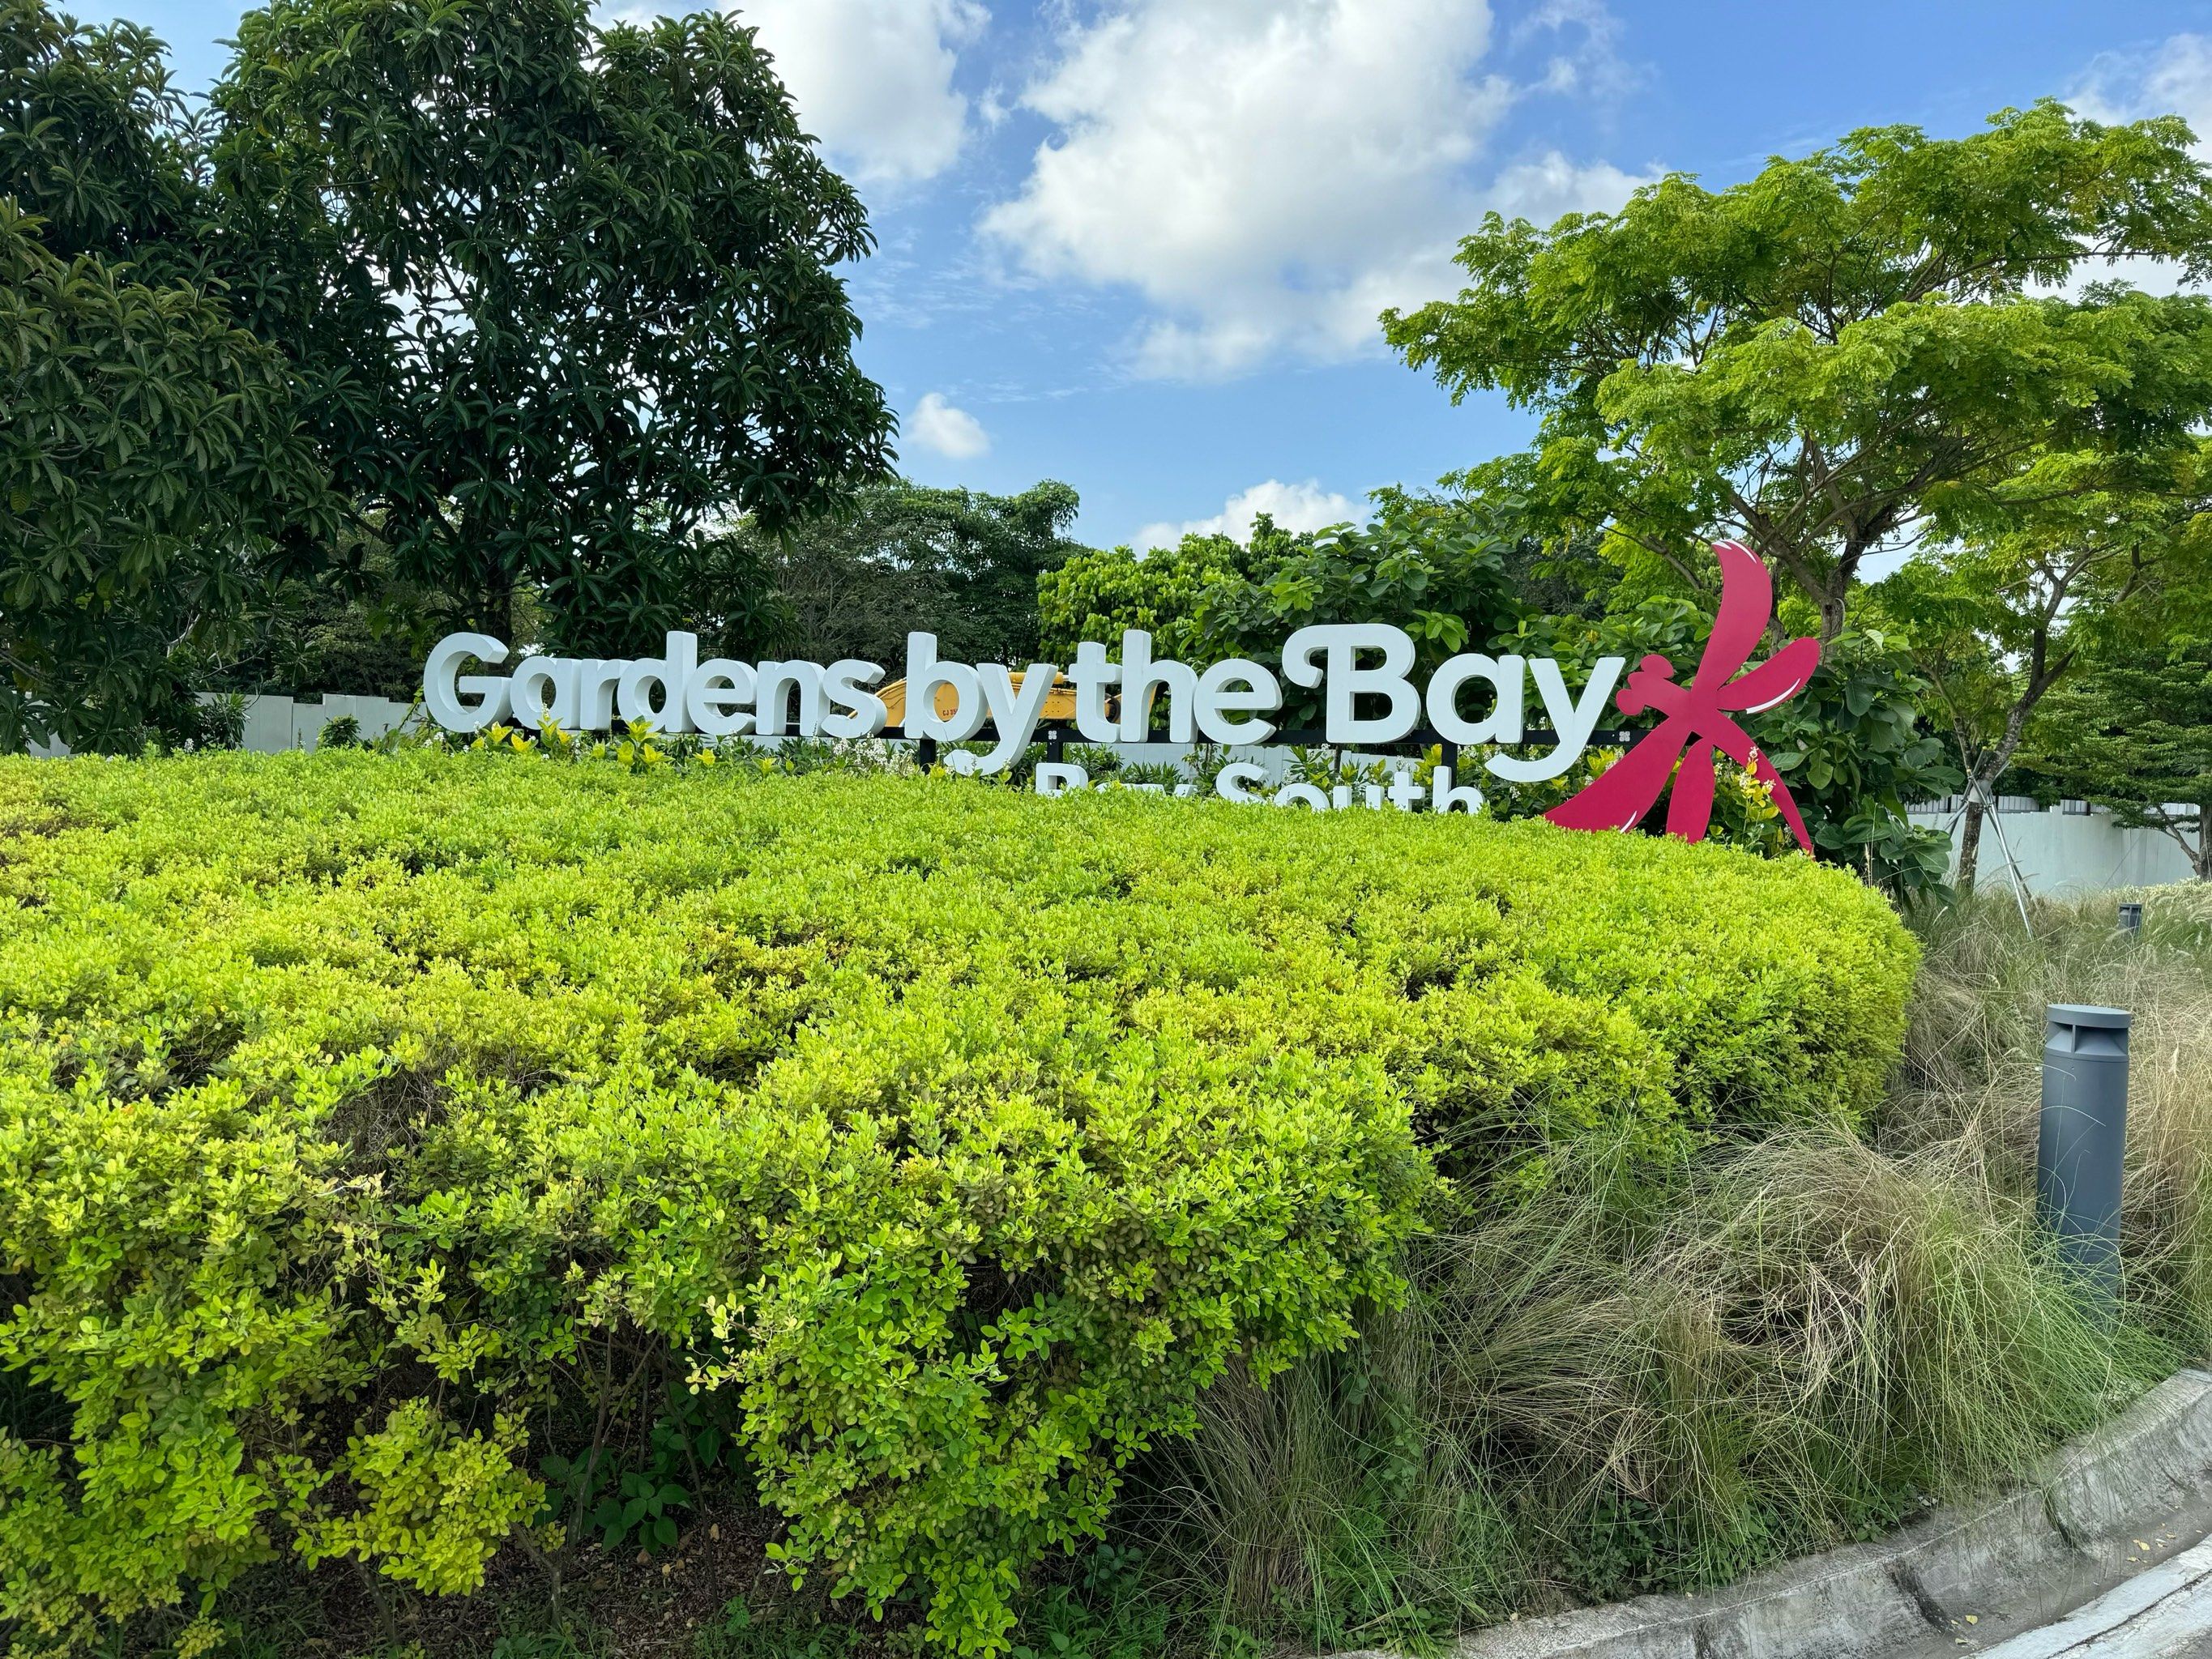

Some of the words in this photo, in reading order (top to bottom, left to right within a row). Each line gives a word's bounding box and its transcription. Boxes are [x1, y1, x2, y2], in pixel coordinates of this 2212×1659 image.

[423, 631, 887, 739] Gardens
[904, 632, 1057, 775] by
[1068, 629, 1283, 745] the
[1282, 623, 1625, 783] Bay
